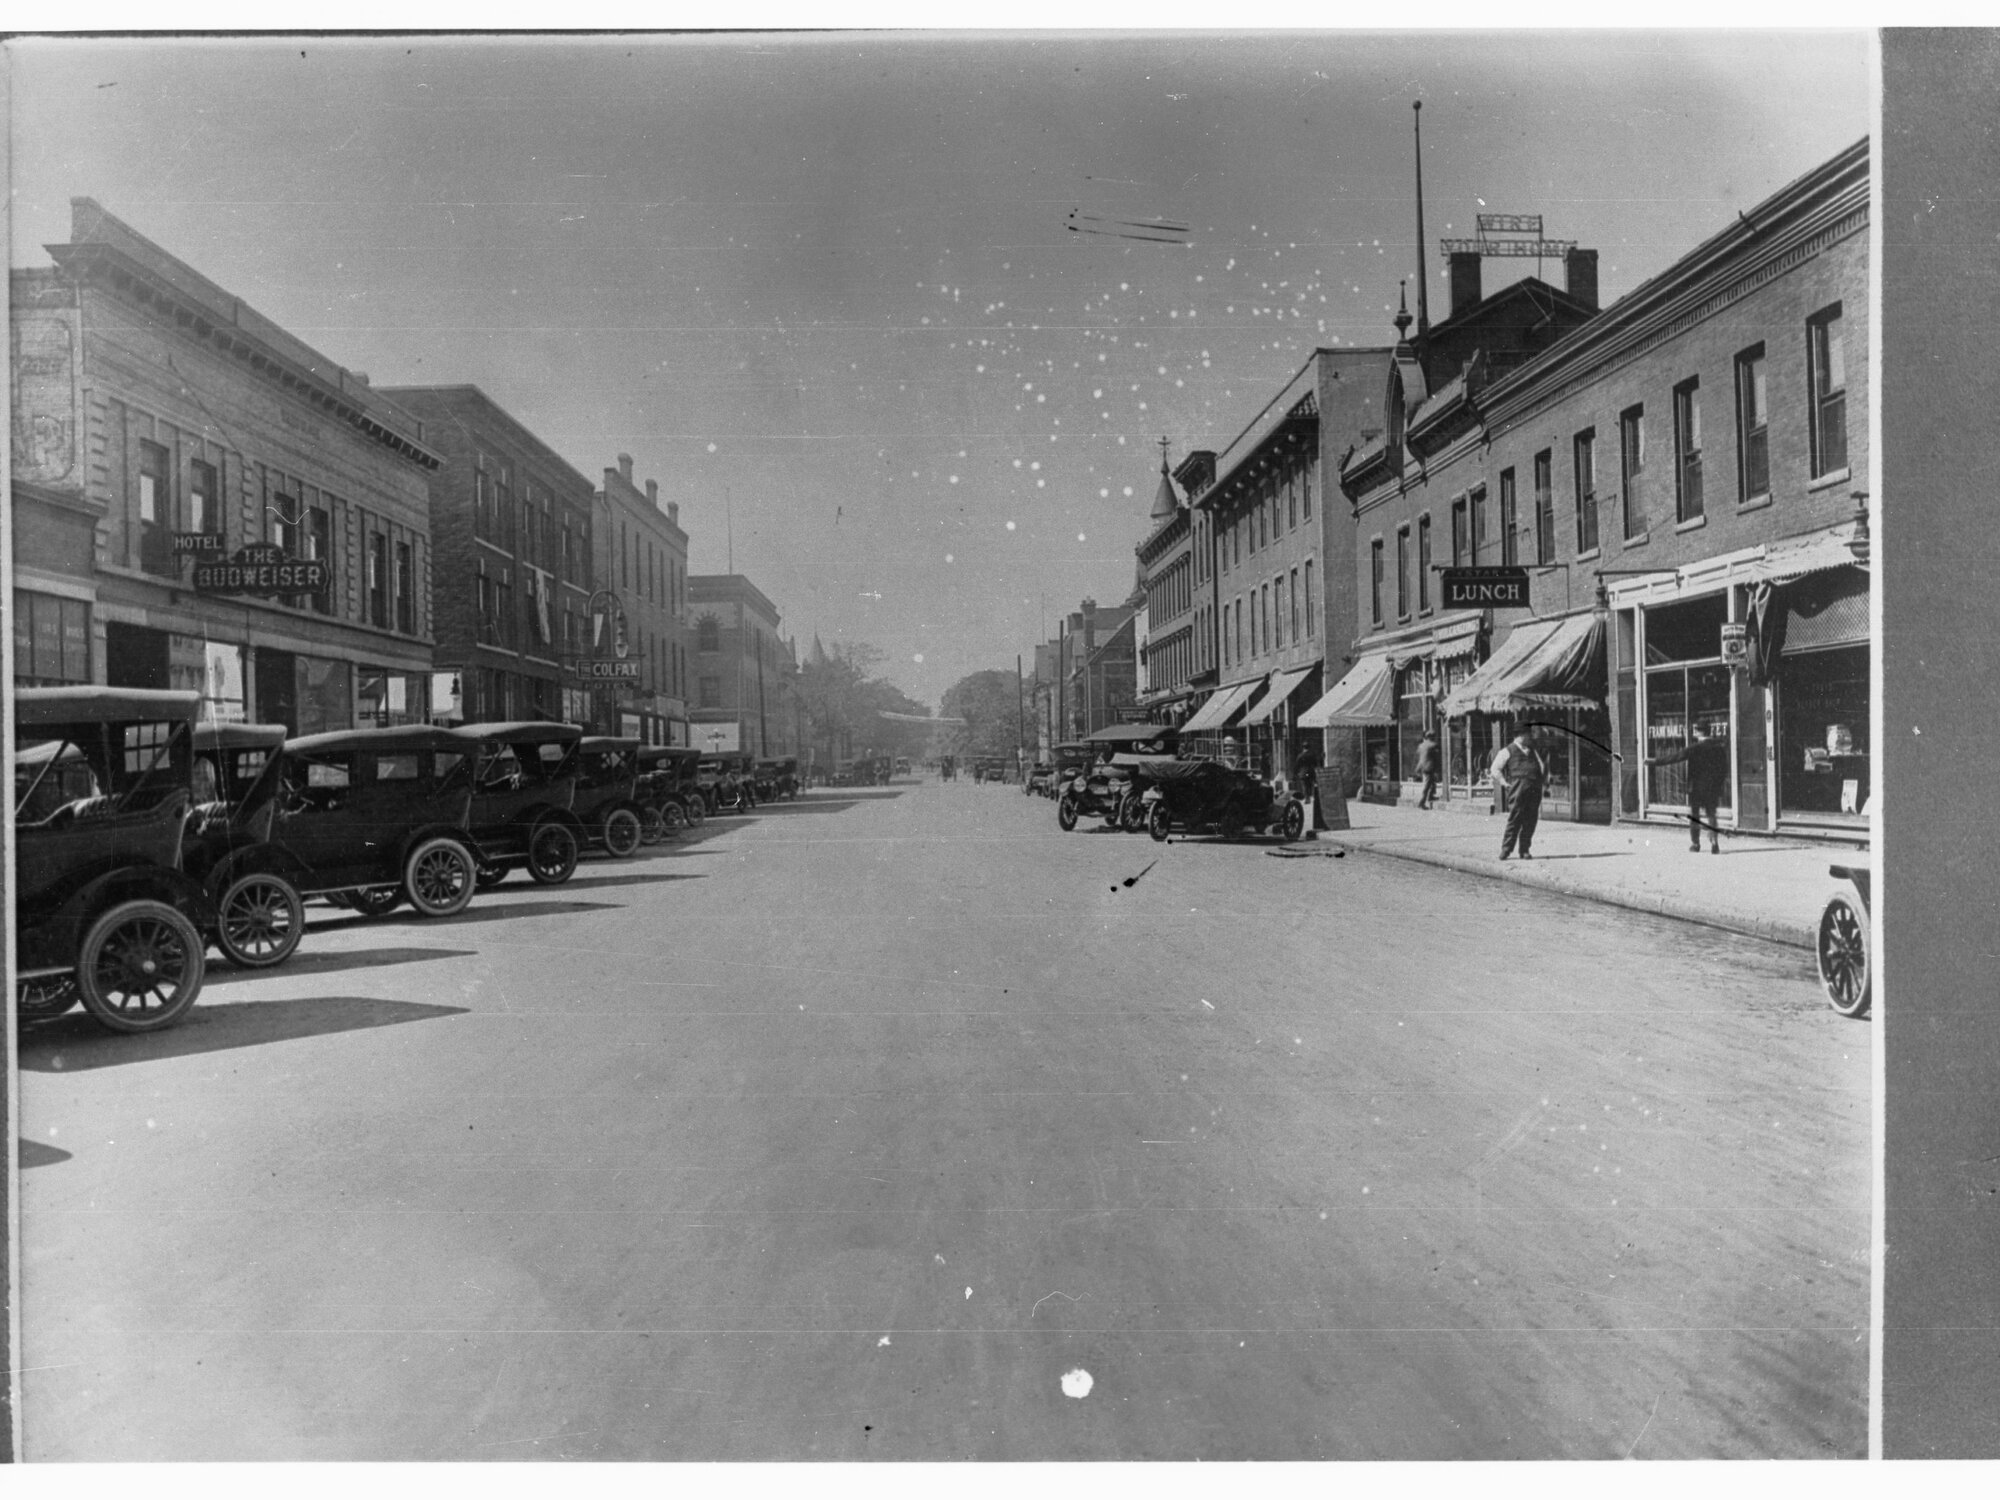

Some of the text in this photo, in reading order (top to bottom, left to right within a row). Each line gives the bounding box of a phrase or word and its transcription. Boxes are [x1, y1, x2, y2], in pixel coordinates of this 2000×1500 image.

[174, 535, 222, 549] HOTEL
[243, 549, 276, 563] THE
[199, 565, 321, 586] BUDWEISER
[1452, 584, 1519, 600] LUNCH
[592, 663, 638, 676] COLFAX
